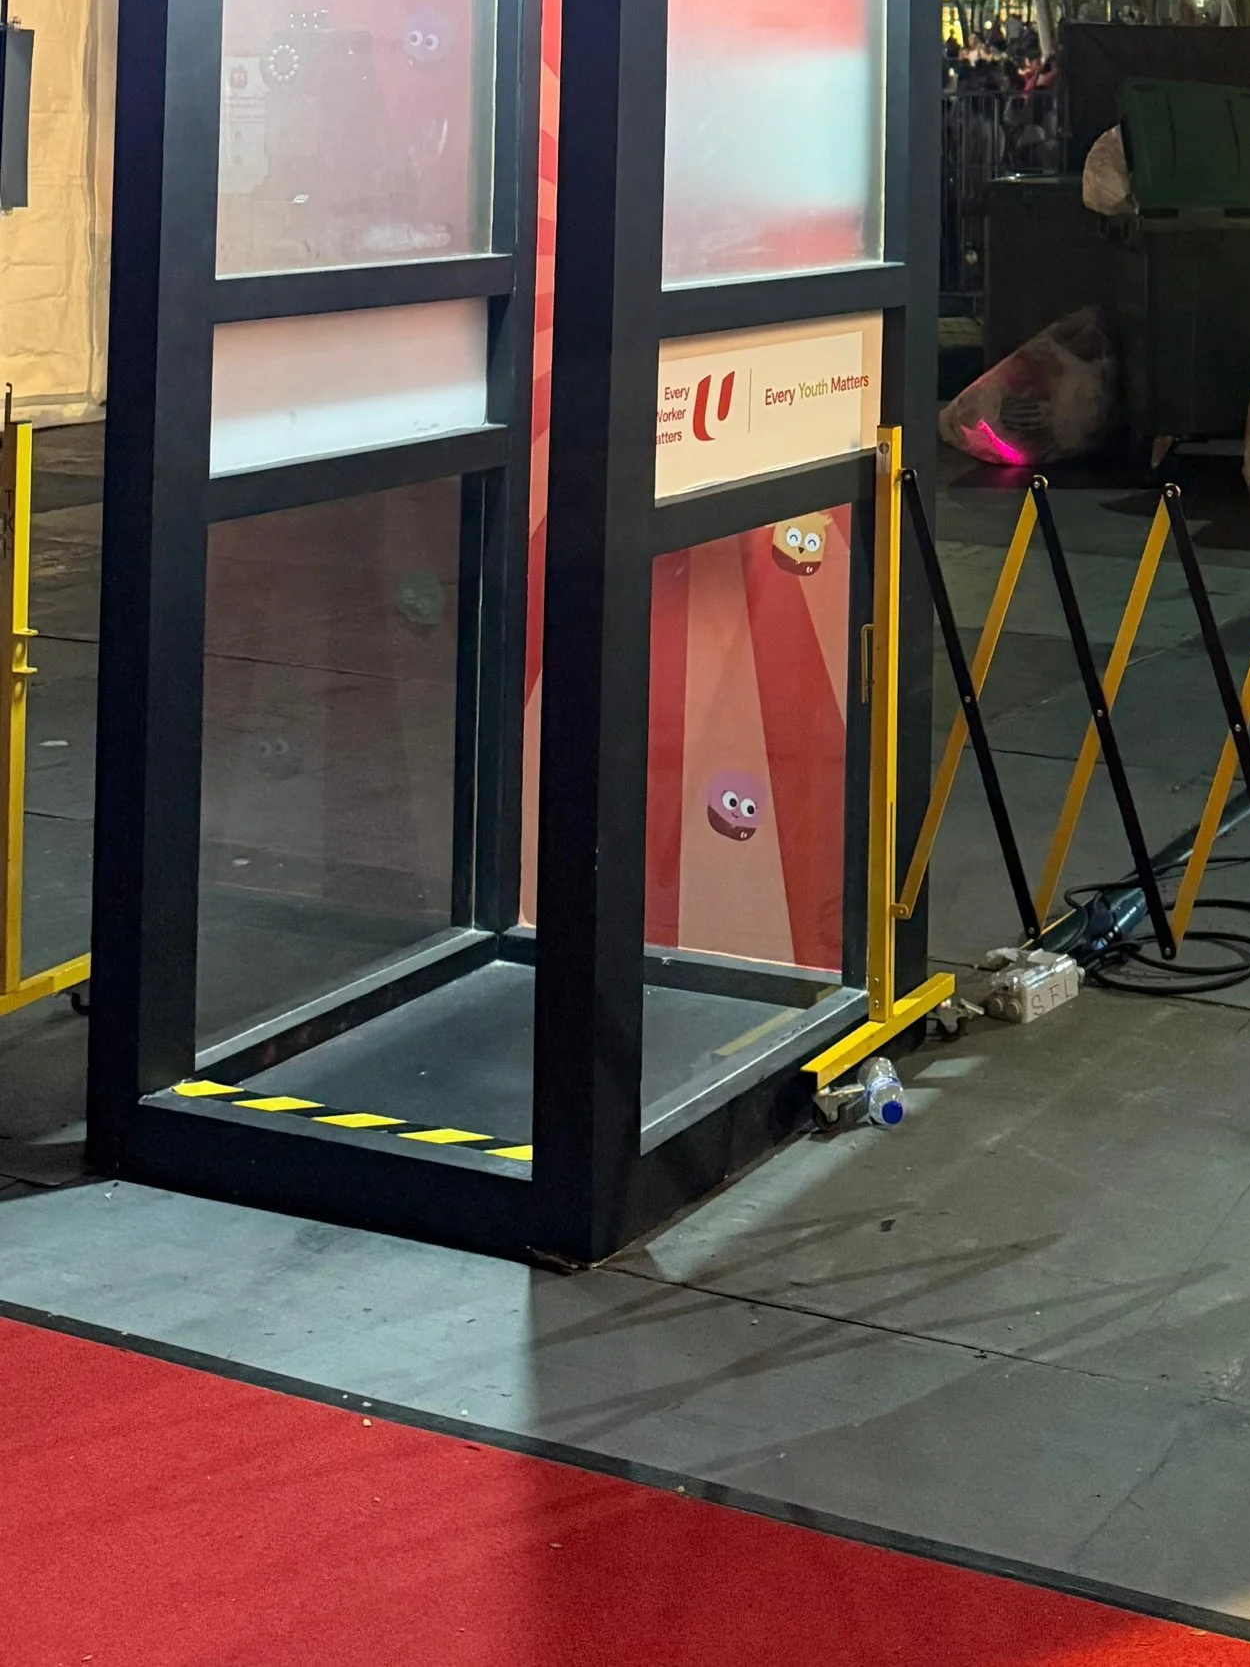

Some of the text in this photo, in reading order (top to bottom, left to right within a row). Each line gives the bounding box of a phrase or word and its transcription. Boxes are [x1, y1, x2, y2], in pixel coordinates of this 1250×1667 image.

[664, 386, 690, 401] Every
[764, 373, 870, 406] Every Youth Matters
[656, 430, 683, 445] atters
